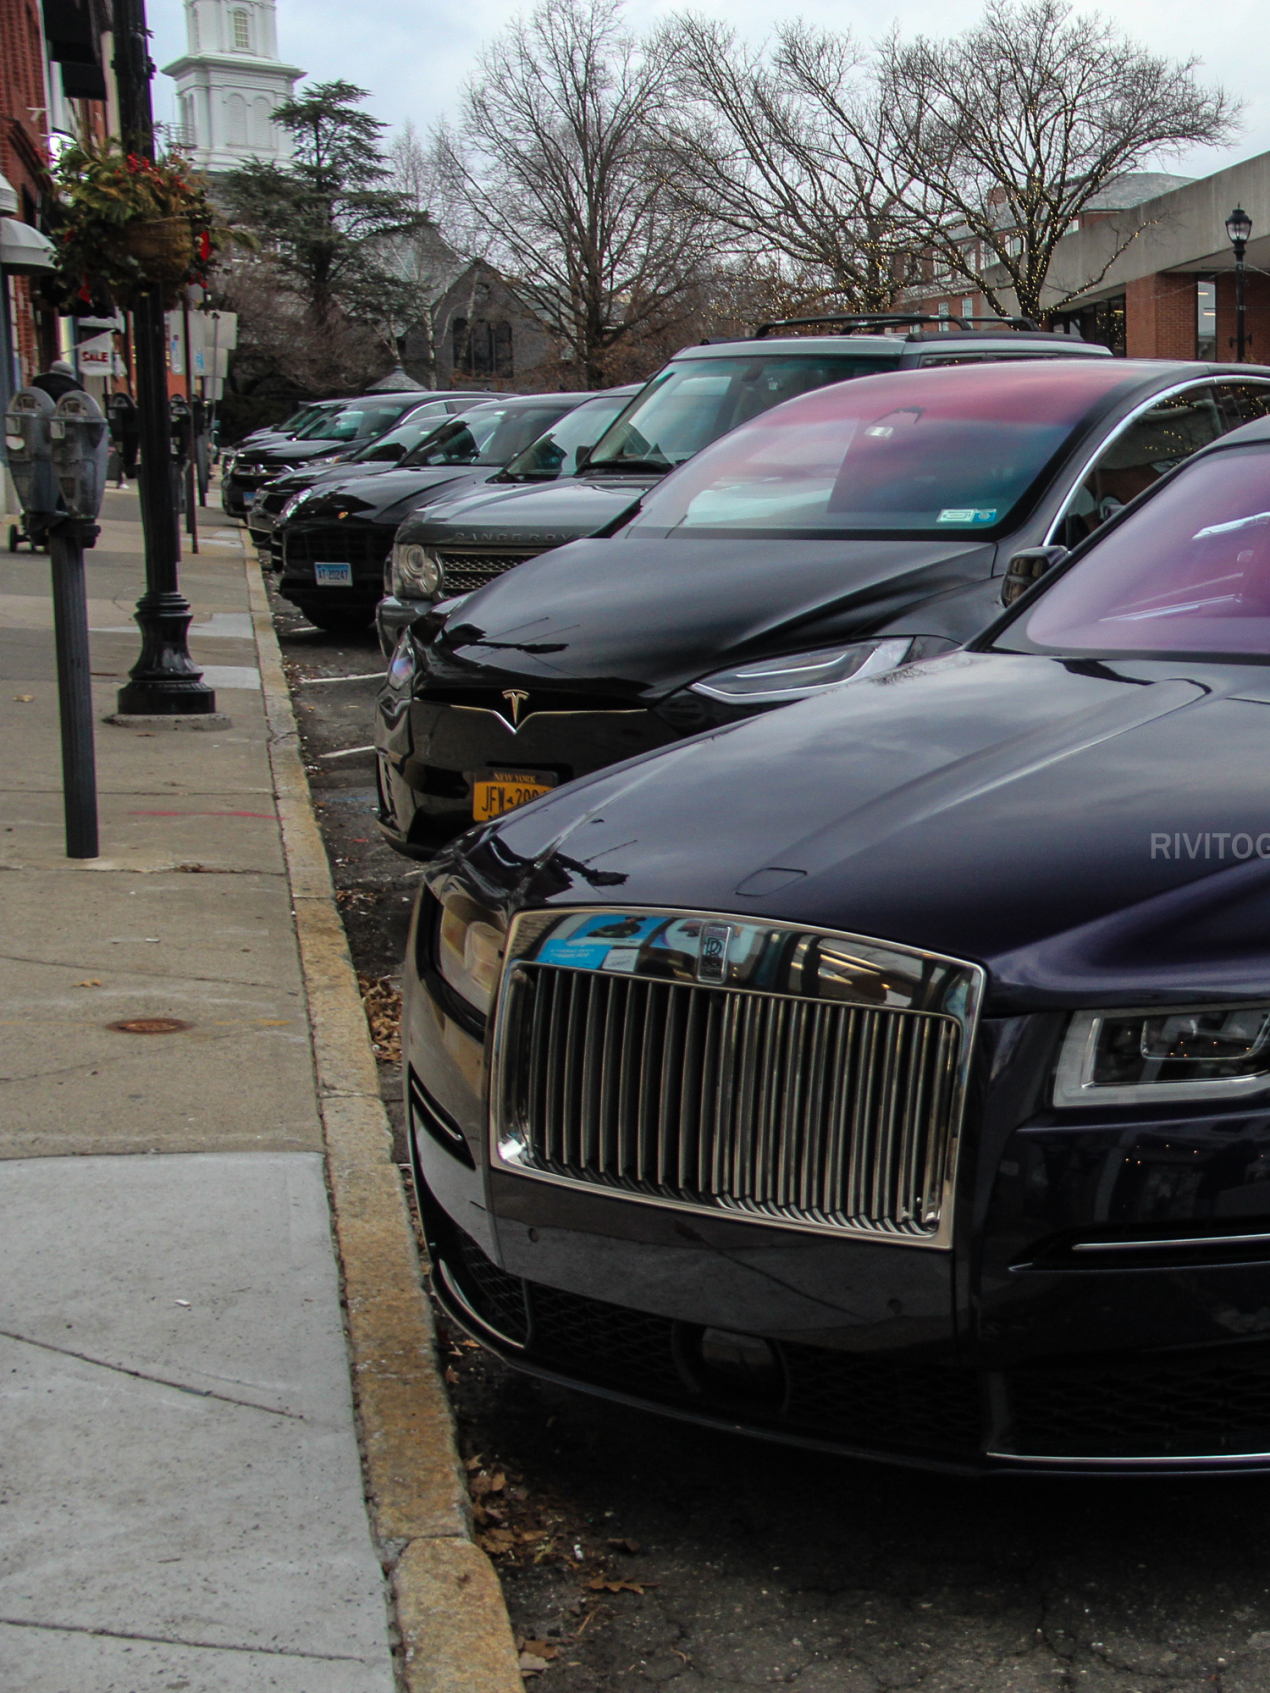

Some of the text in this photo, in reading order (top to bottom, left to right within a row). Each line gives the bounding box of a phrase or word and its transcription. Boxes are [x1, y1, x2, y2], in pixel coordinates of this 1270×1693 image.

[82, 351, 108, 363] SALE
[494, 773, 536, 784] NEW YORK
